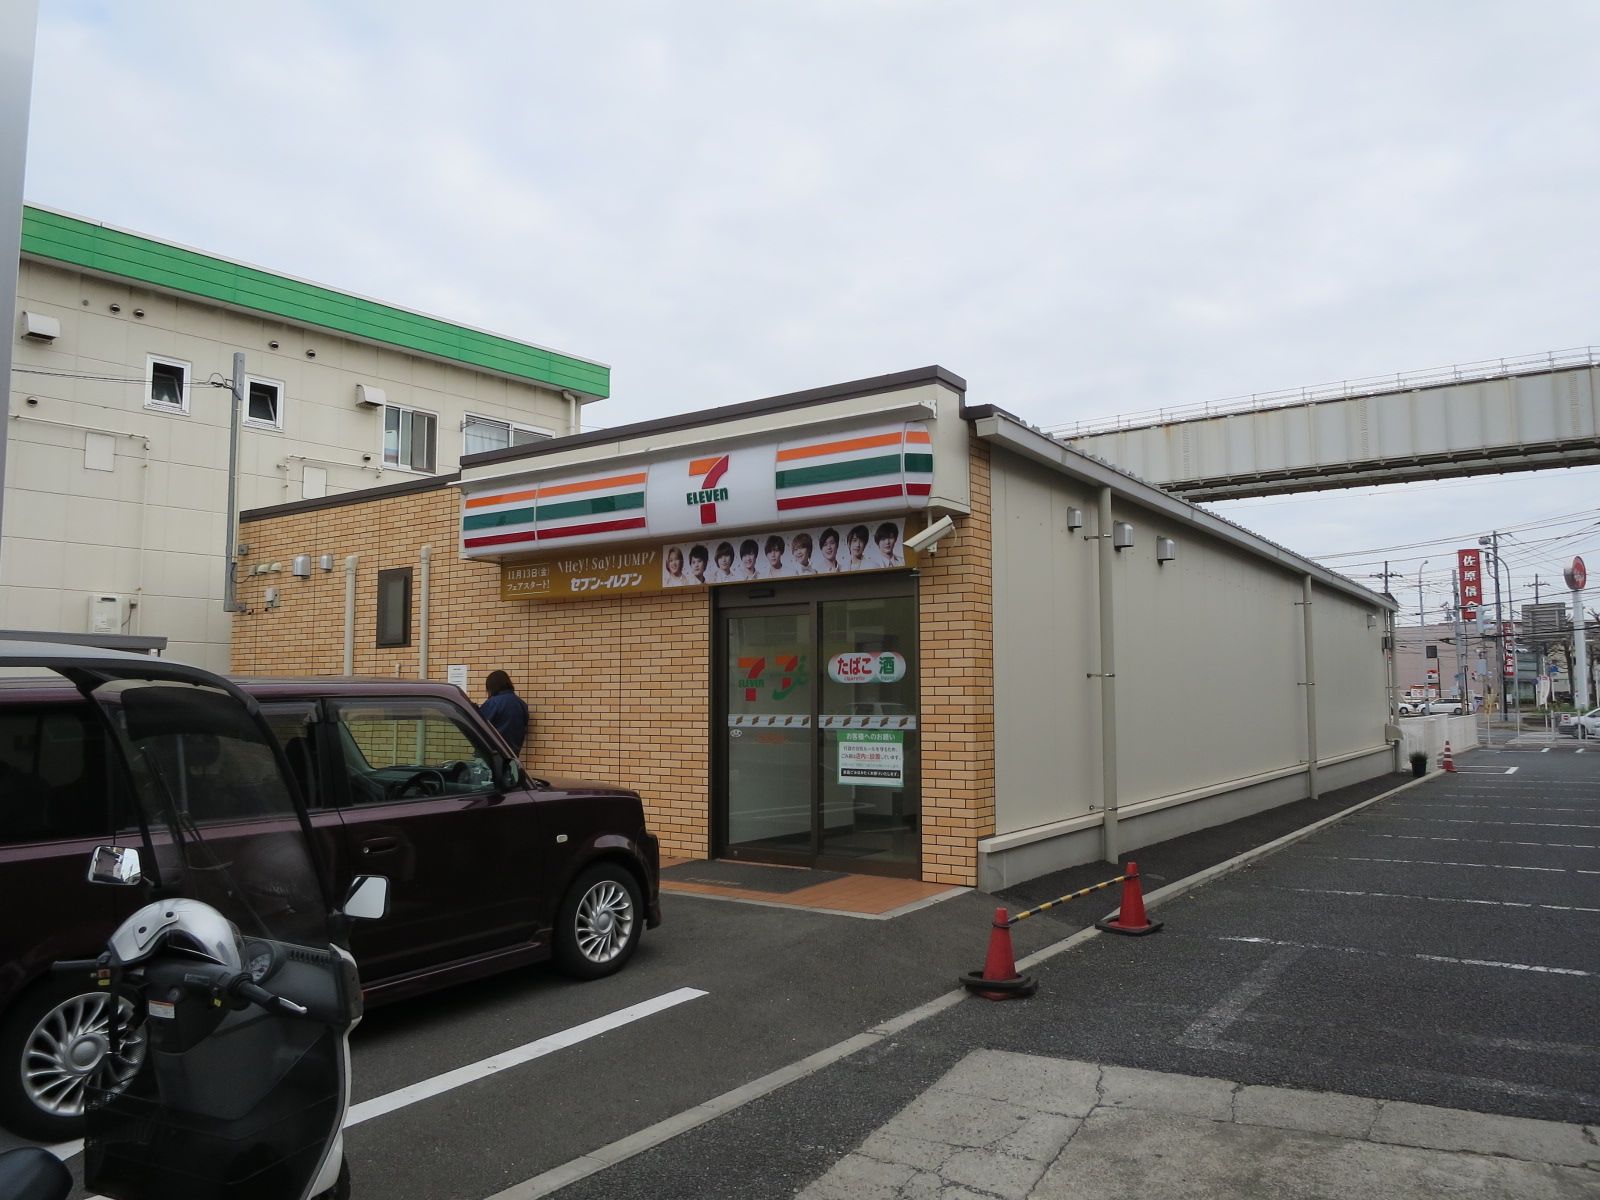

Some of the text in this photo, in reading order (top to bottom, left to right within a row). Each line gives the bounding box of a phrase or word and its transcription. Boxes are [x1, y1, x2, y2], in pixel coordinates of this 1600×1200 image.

[837, 655, 895, 675] たばこ 酒
[846, 732, 896, 741] お客様へのお願い
